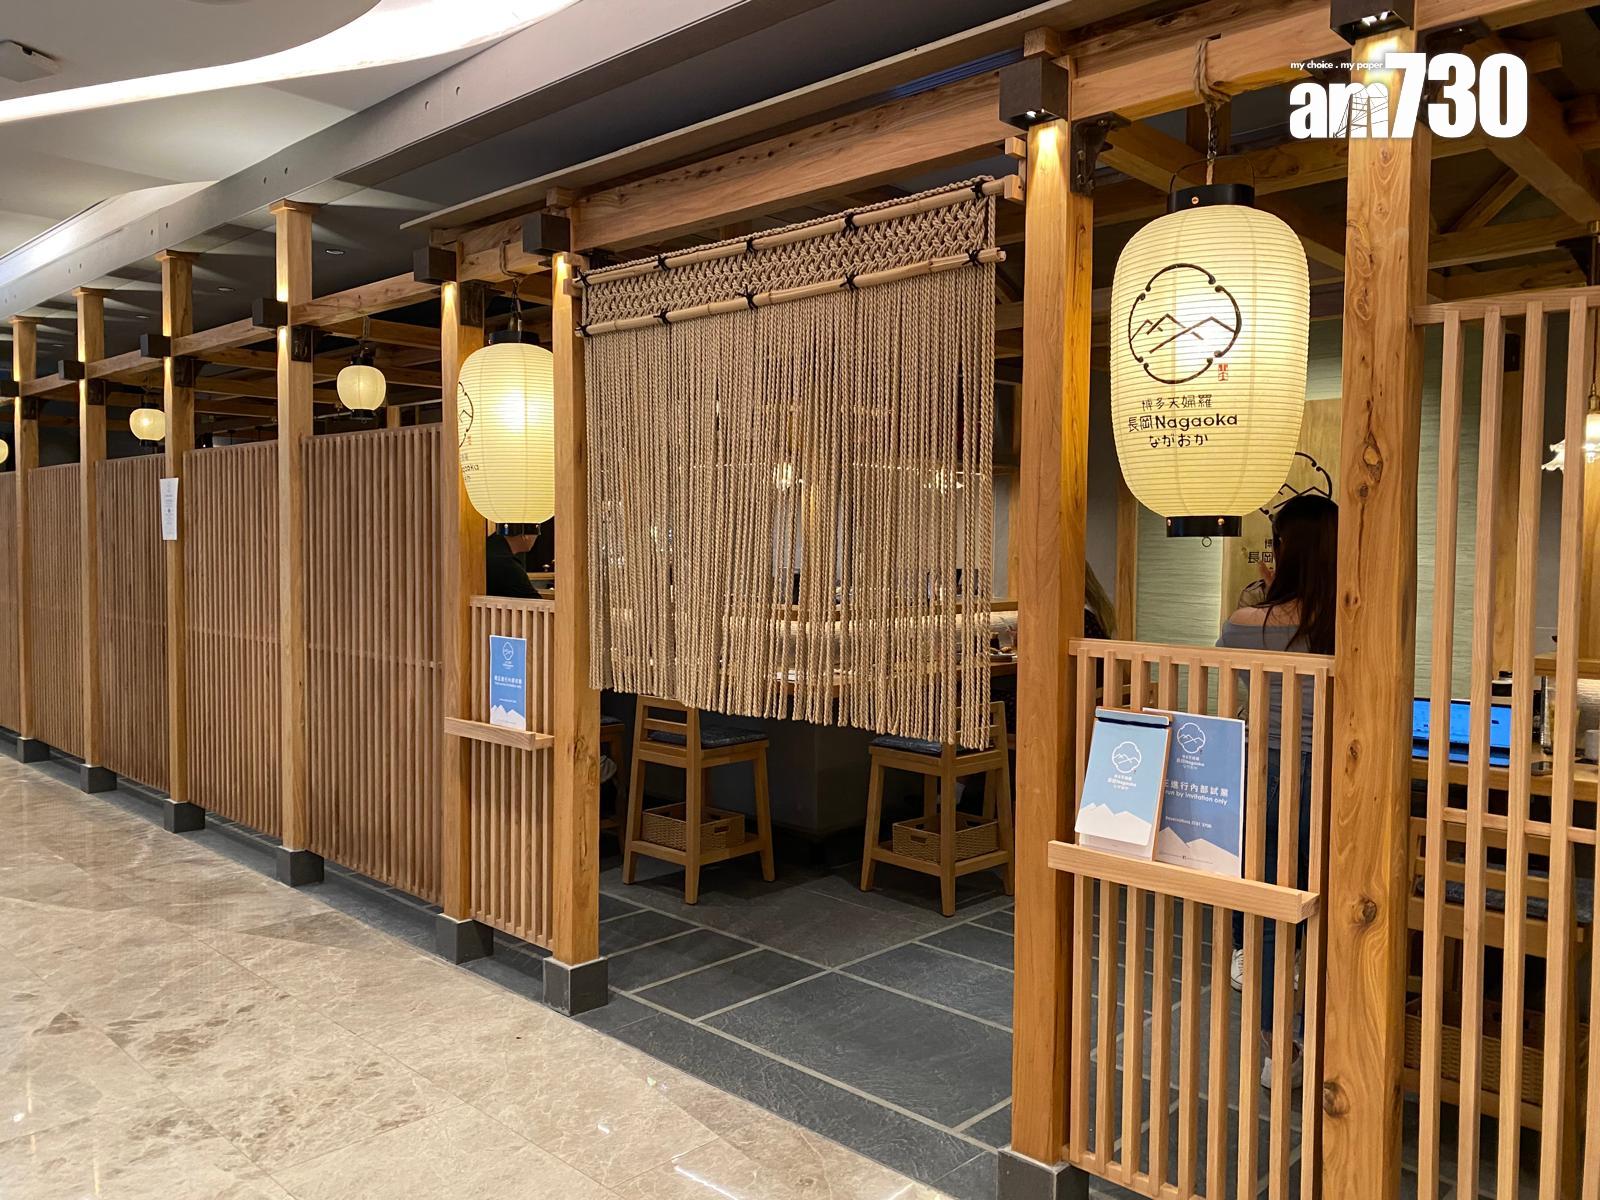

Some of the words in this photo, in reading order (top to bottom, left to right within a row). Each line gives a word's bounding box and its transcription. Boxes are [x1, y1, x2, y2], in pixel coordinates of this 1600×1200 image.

[1149, 433, 1208, 448] ながおか
[1185, 792, 1213, 803] invitation
[1214, 797, 1228, 806] only
